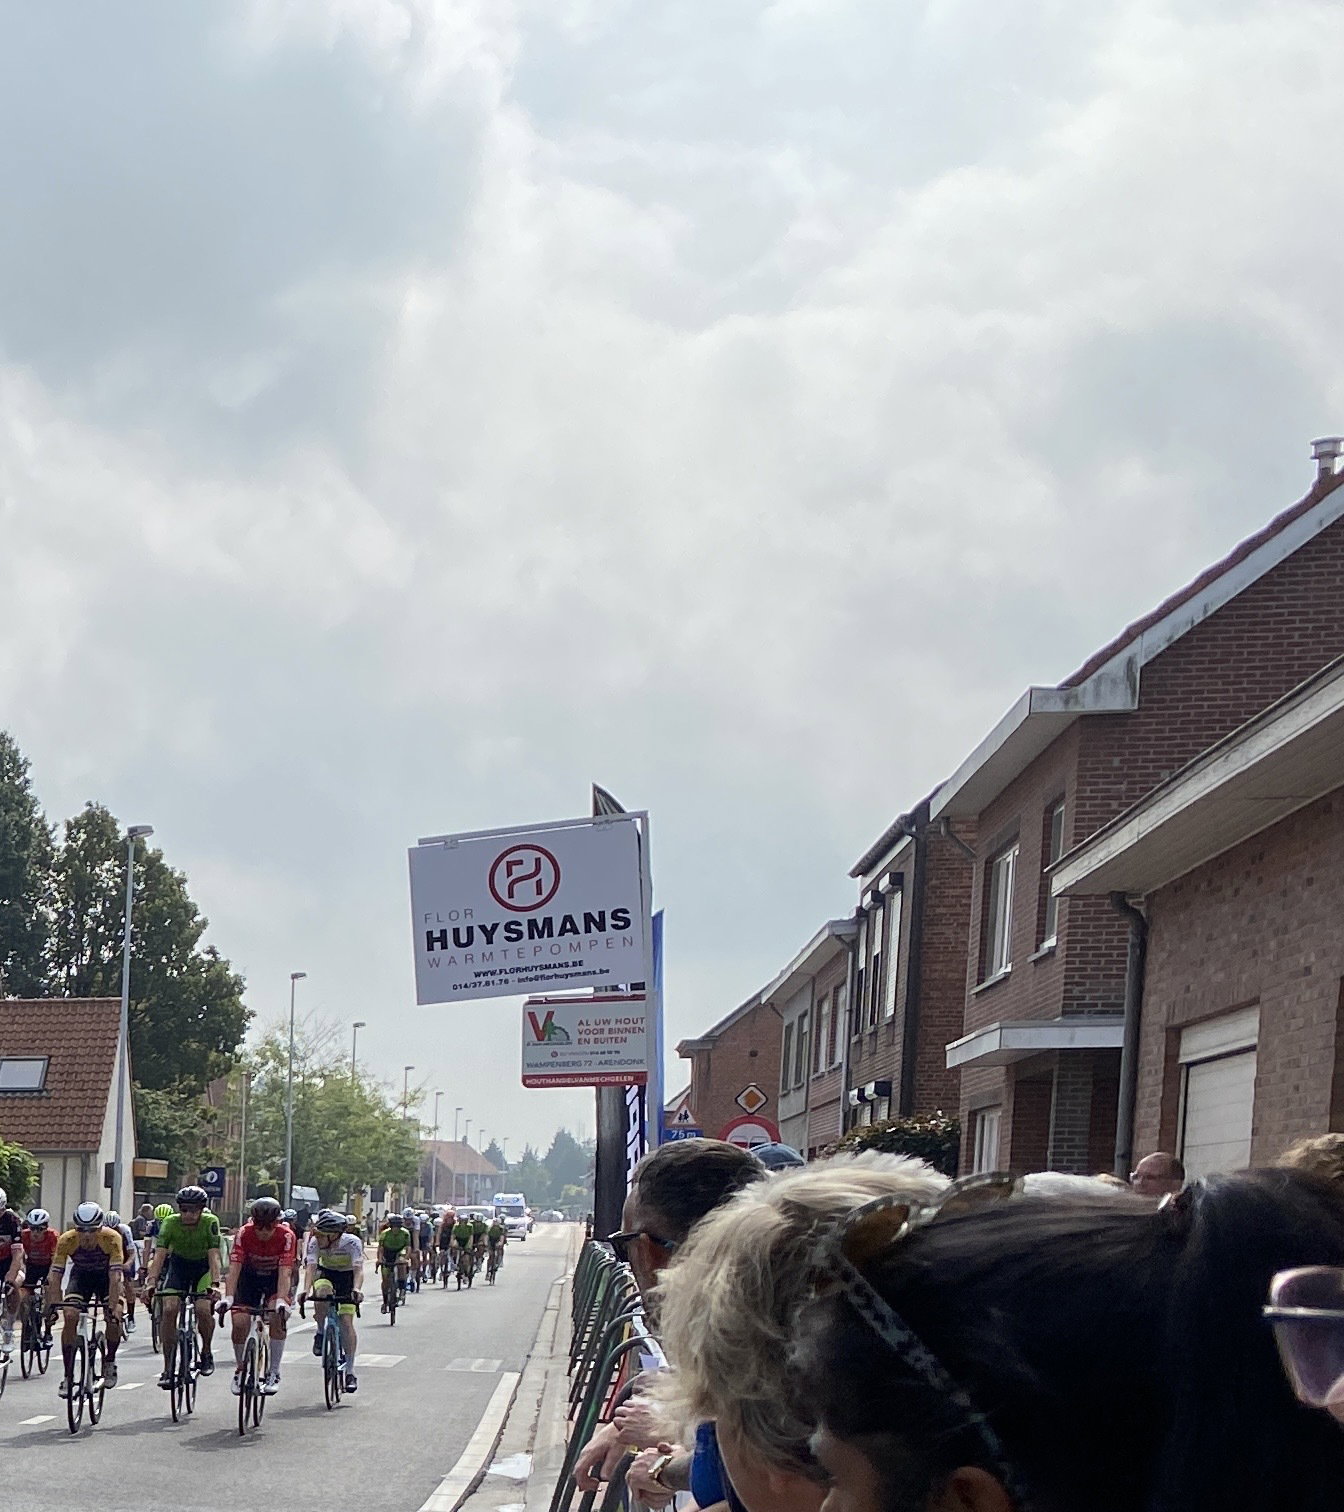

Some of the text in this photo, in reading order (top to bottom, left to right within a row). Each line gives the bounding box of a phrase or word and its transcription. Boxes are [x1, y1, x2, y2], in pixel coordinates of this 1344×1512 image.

[424, 908, 474, 924] FLOR
[426, 908, 632, 952] HUYSMANS
[428, 935, 633, 968] WARMTEPOMPEN
[473, 960, 585, 978] WWW.FLORHUYSMANS.BE
[578, 1016, 645, 1027] AL UW HOUT
[577, 1026, 645, 1036] VOOR BINNEN
[578, 1037, 591, 1045] EN
[594, 1036, 628, 1045] BUITEN
[526, 1060, 582, 1068] WAMPENBERG
[598, 1059, 645, 1067] ARENDONK
[671, 1130, 685, 1139] 75
